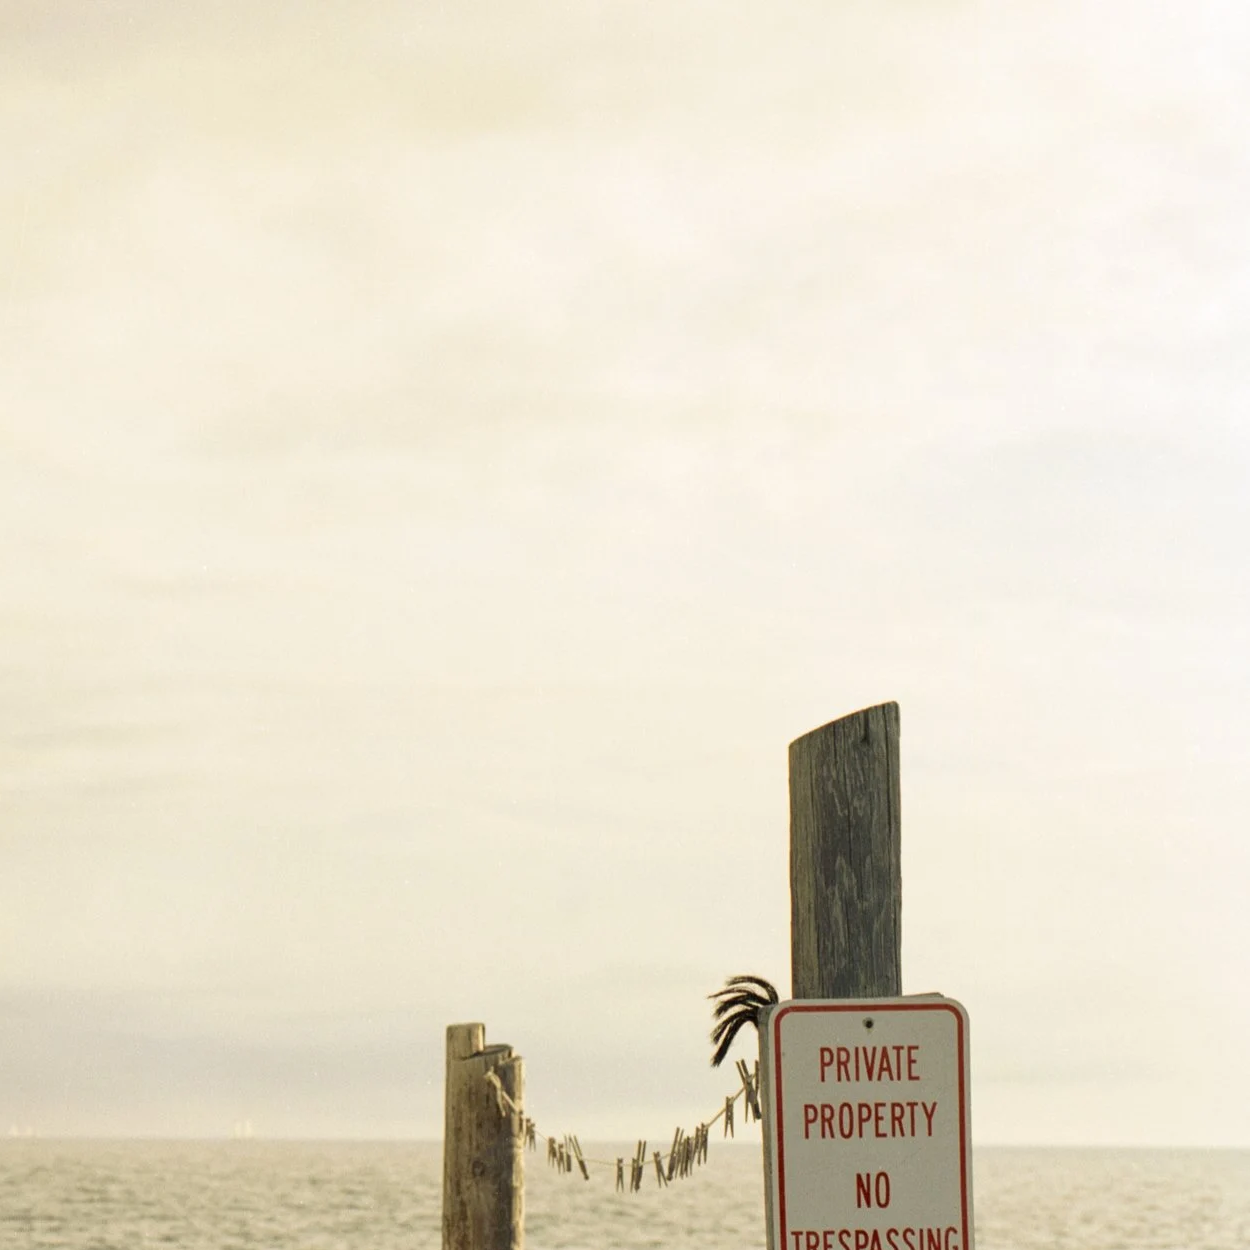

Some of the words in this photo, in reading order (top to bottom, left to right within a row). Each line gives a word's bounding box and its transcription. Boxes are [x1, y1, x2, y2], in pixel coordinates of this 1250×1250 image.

[819, 1045, 921, 1083] PRIVATE
[803, 1101, 938, 1139] PROPERTY
[855, 1171, 891, 1209] NO
